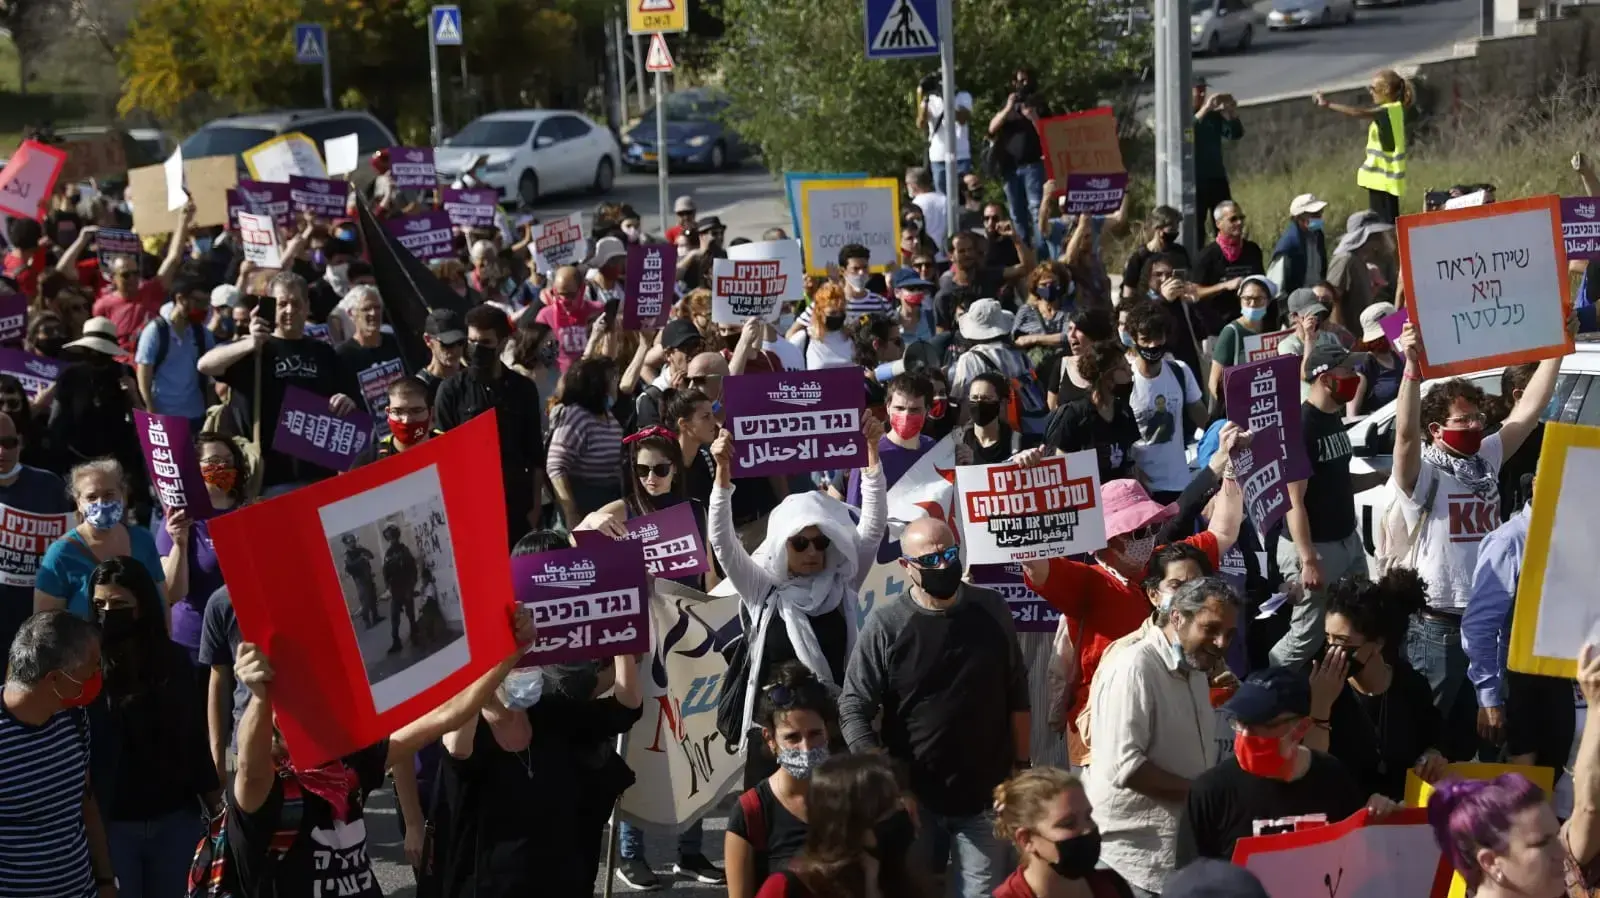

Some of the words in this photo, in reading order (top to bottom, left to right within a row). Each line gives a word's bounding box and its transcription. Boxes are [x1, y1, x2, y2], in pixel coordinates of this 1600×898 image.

[831, 201, 868, 219] STOP
[844, 220, 860, 230] THE
[1492, 248, 1529, 272] שייח
[737, 264, 777, 279] השכנים
[1472, 280, 1502, 303] היא
[1452, 296, 1525, 344] פלסטין
[790, 391, 822, 399] עומדים
[1254, 381, 1273, 393] נגד
[740, 416, 816, 436] הכיבוש
[820, 413, 852, 430] נגד
[739, 438, 818, 468] الاحتلال
[823, 439, 858, 458] ضد
[993, 463, 1062, 493] השכנים
[1256, 466, 1277, 489] נגד
[972, 491, 1038, 518] בסכנה!
[1044, 483, 1089, 510] שלנו
[7, 513, 62, 537] השכנים
[990, 517, 1023, 531] הגירוש
[1026, 516, 1041, 529] את
[1044, 511, 1076, 527] עוצרים
[0, 529, 36, 553] בסכנ
[661, 539, 690, 554] נגד
[1038, 543, 1065, 557] שלום
[669, 555, 698, 571] ضد
[1010, 550, 1037, 560] עכשיו
[570, 559, 596, 571] نقف
[531, 574, 557, 584] ביחד
[559, 571, 596, 581] עומדים
[533, 600, 590, 623] הכיב
[595, 594, 632, 615] נגד
[598, 621, 637, 645] ضد
